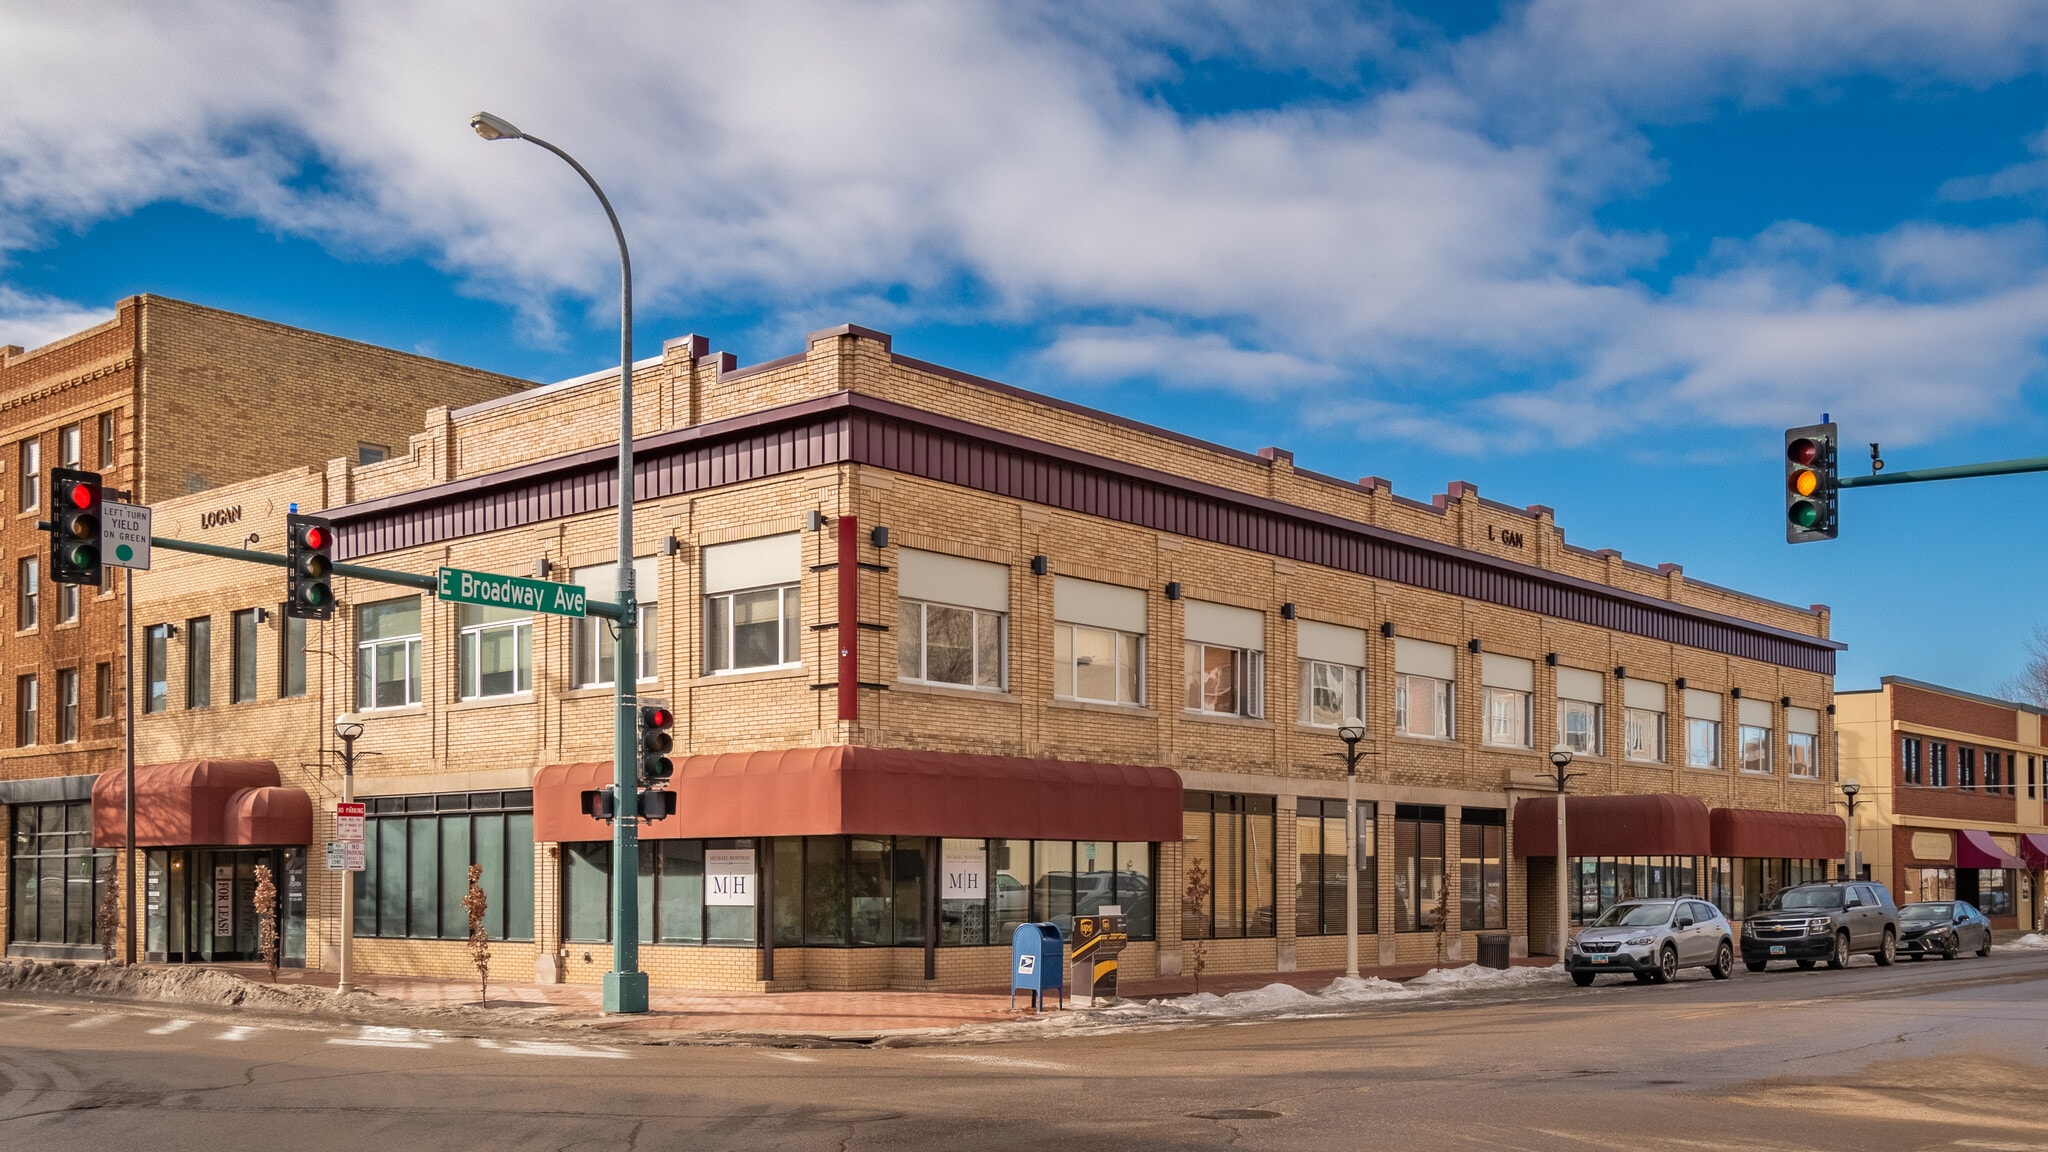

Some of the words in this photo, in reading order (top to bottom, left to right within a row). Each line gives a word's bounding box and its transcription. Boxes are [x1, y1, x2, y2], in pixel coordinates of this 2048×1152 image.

[104, 507, 123, 517] LEFT
[127, 510, 147, 520] TURN
[201, 505, 242, 529] LOGAN
[112, 518, 139, 531] YIELD
[104, 530, 115, 539] ON
[120, 532, 146, 543] GREEN
[440, 570, 452, 595] E
[461, 572, 544, 611] Broadway
[554, 585, 584, 612] Ave
[218, 882, 229, 901] FOR
[218, 905, 229, 934] LEASE
